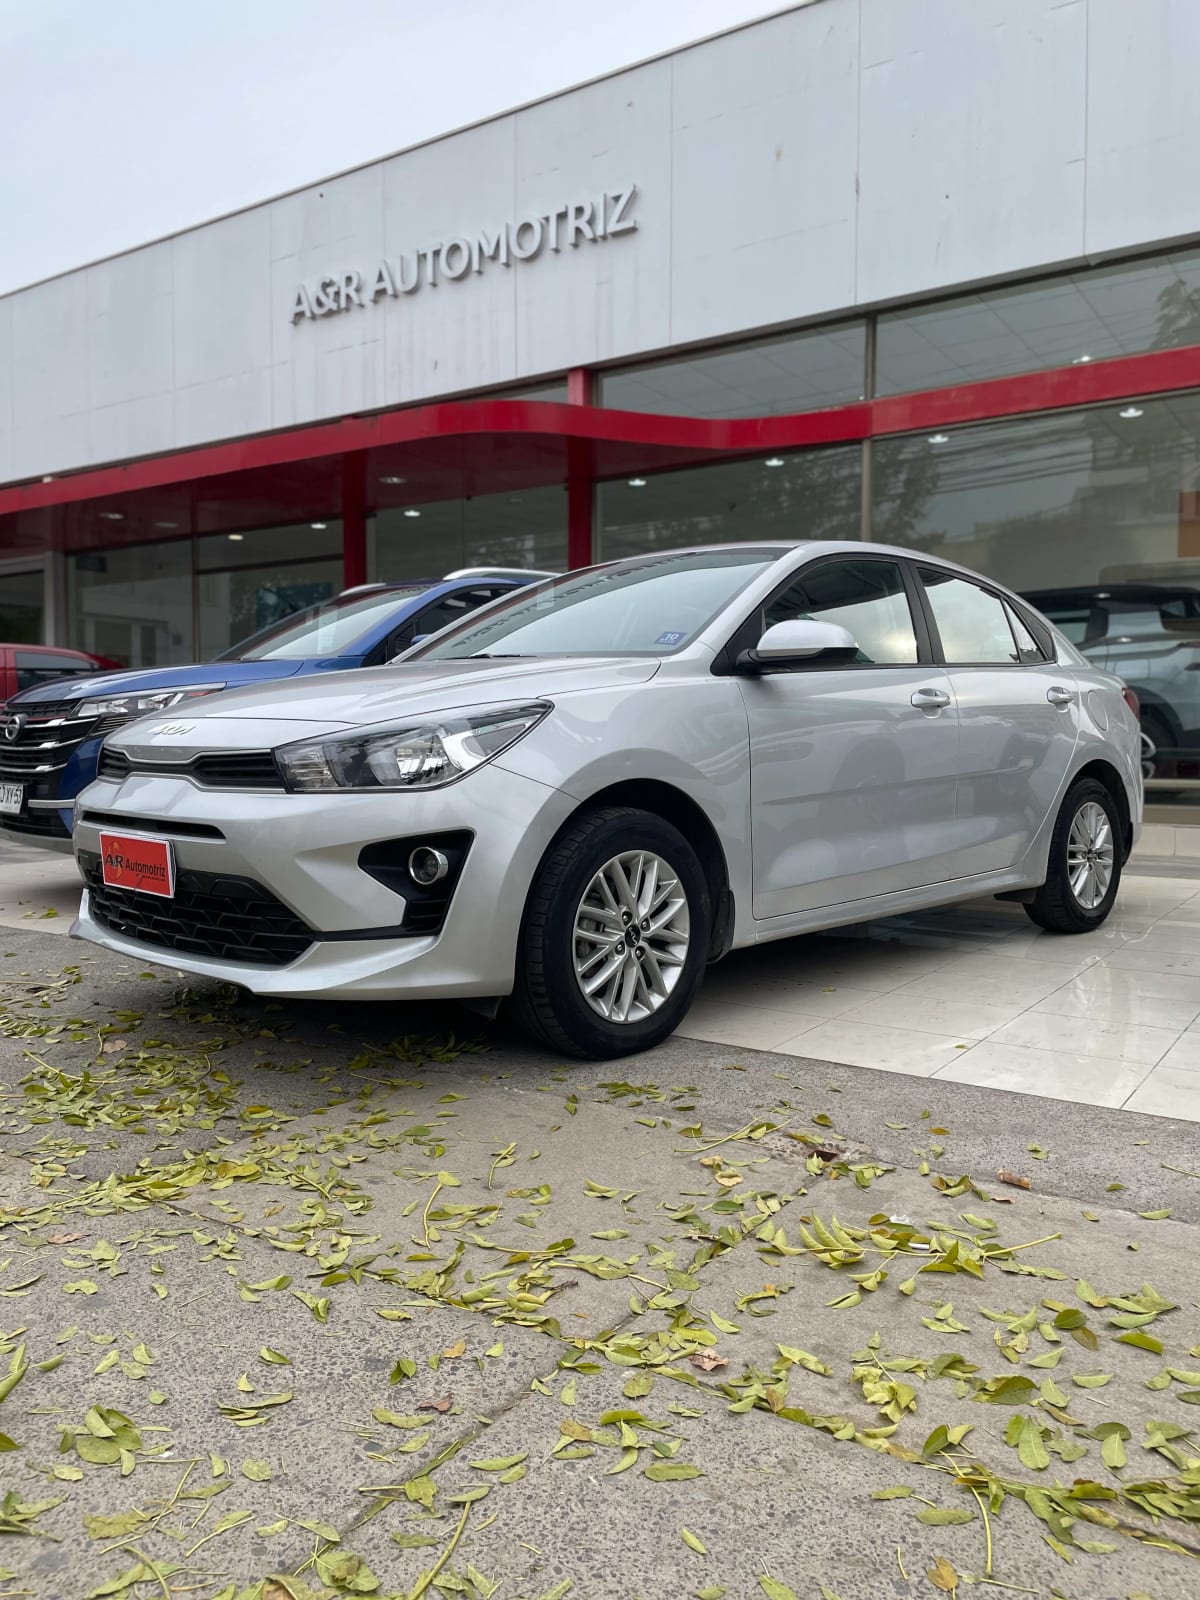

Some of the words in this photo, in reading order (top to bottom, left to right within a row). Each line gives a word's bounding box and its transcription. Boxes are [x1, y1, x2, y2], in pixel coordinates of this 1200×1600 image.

[289, 269, 365, 326] A&R
[369, 184, 639, 304] AUTOMOTRIZ
[125, 858, 167, 878] Automotriz
